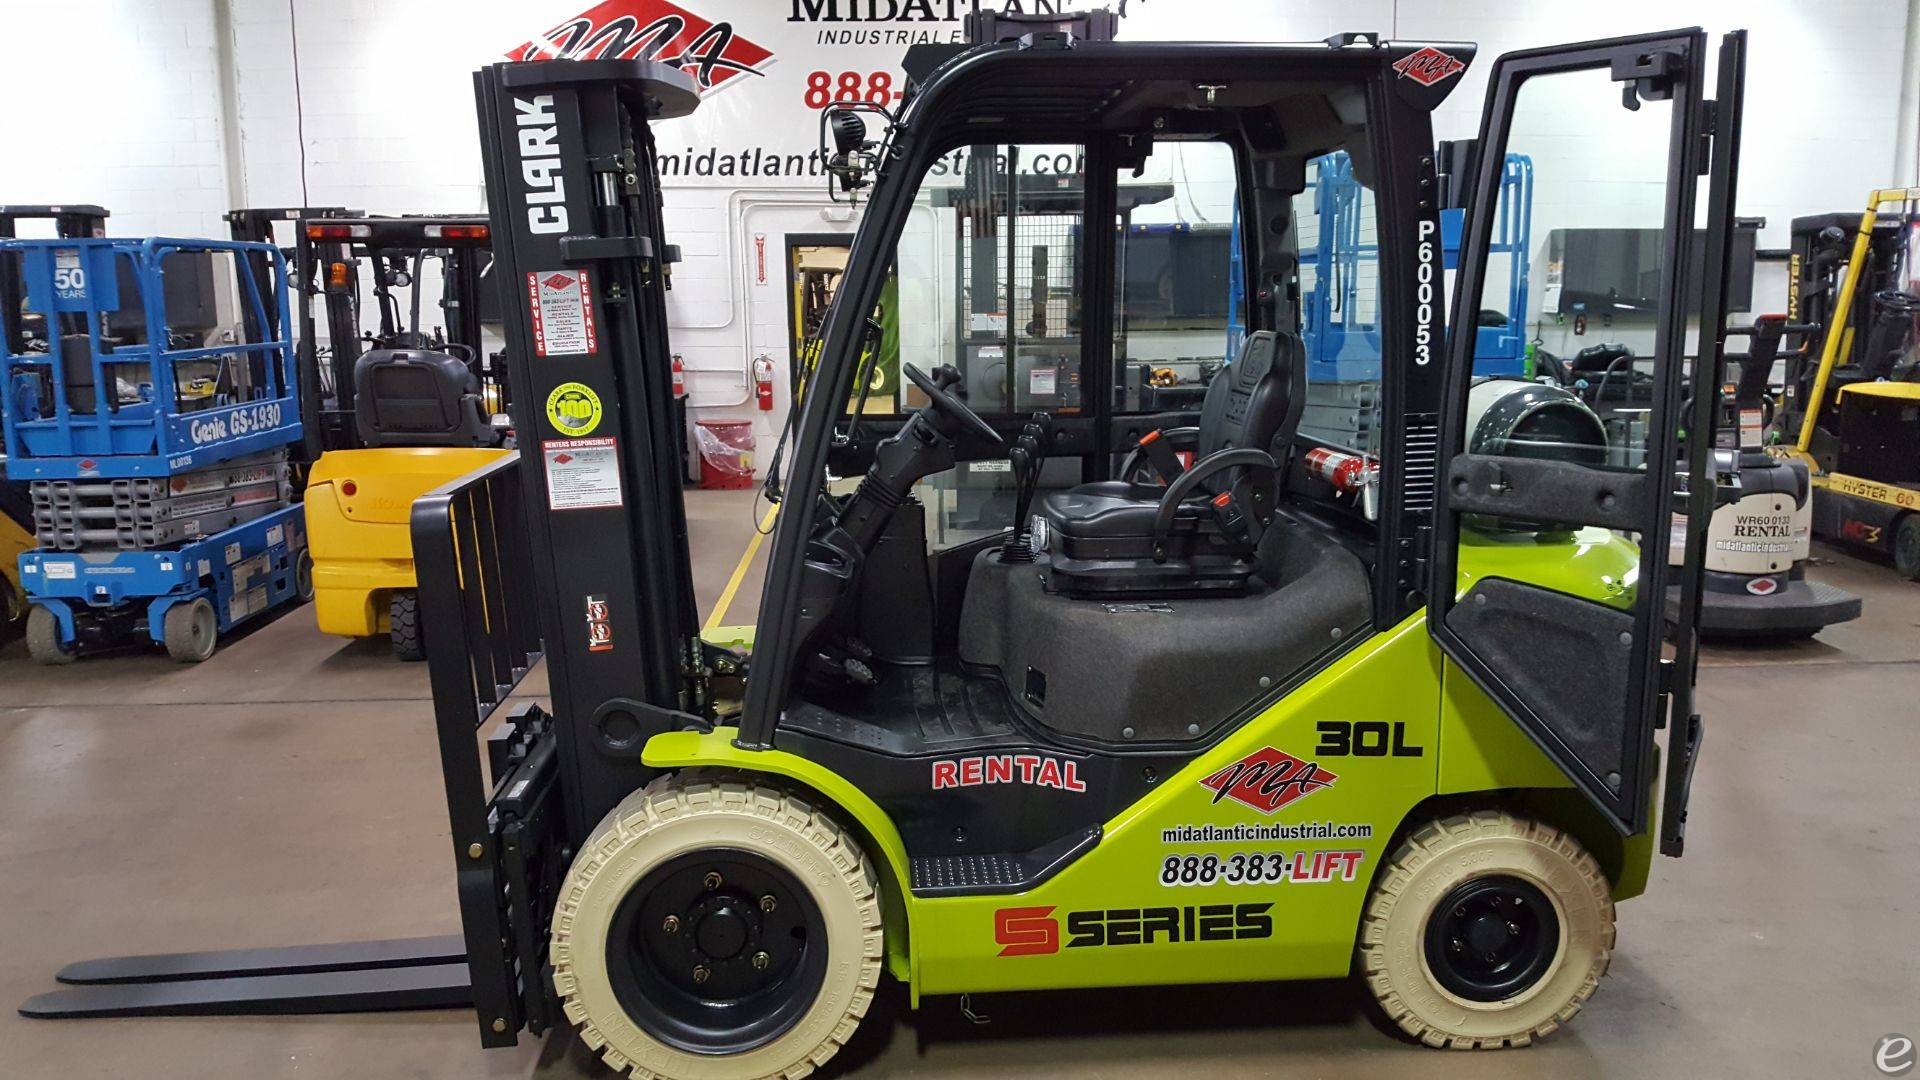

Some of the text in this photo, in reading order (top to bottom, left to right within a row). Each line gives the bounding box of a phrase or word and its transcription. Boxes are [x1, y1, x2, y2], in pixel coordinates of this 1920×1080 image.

[817, 30, 944, 44] INDUSTRIAL
[513, 94, 570, 235] CLARK
[54, 268, 85, 290] 50
[55, 289, 87, 299] YEARS
[1415, 220, 1435, 366] P600053
[1788, 253, 1801, 321] HYSTER
[529, 275, 545, 352] SERVICE
[579, 271, 596, 349] RENTALS
[191, 403, 281, 445] Genie GS-1930
[1843, 479, 1888, 501] HYSTER
[1733, 525, 1791, 538] RENTAL
[1315, 721, 1424, 757] 30L
[932, 755, 1087, 793] RENTAL
[1162, 822, 1373, 842] midatlanticindustrial.com
[994, 902, 1276, 958] S SERIES
